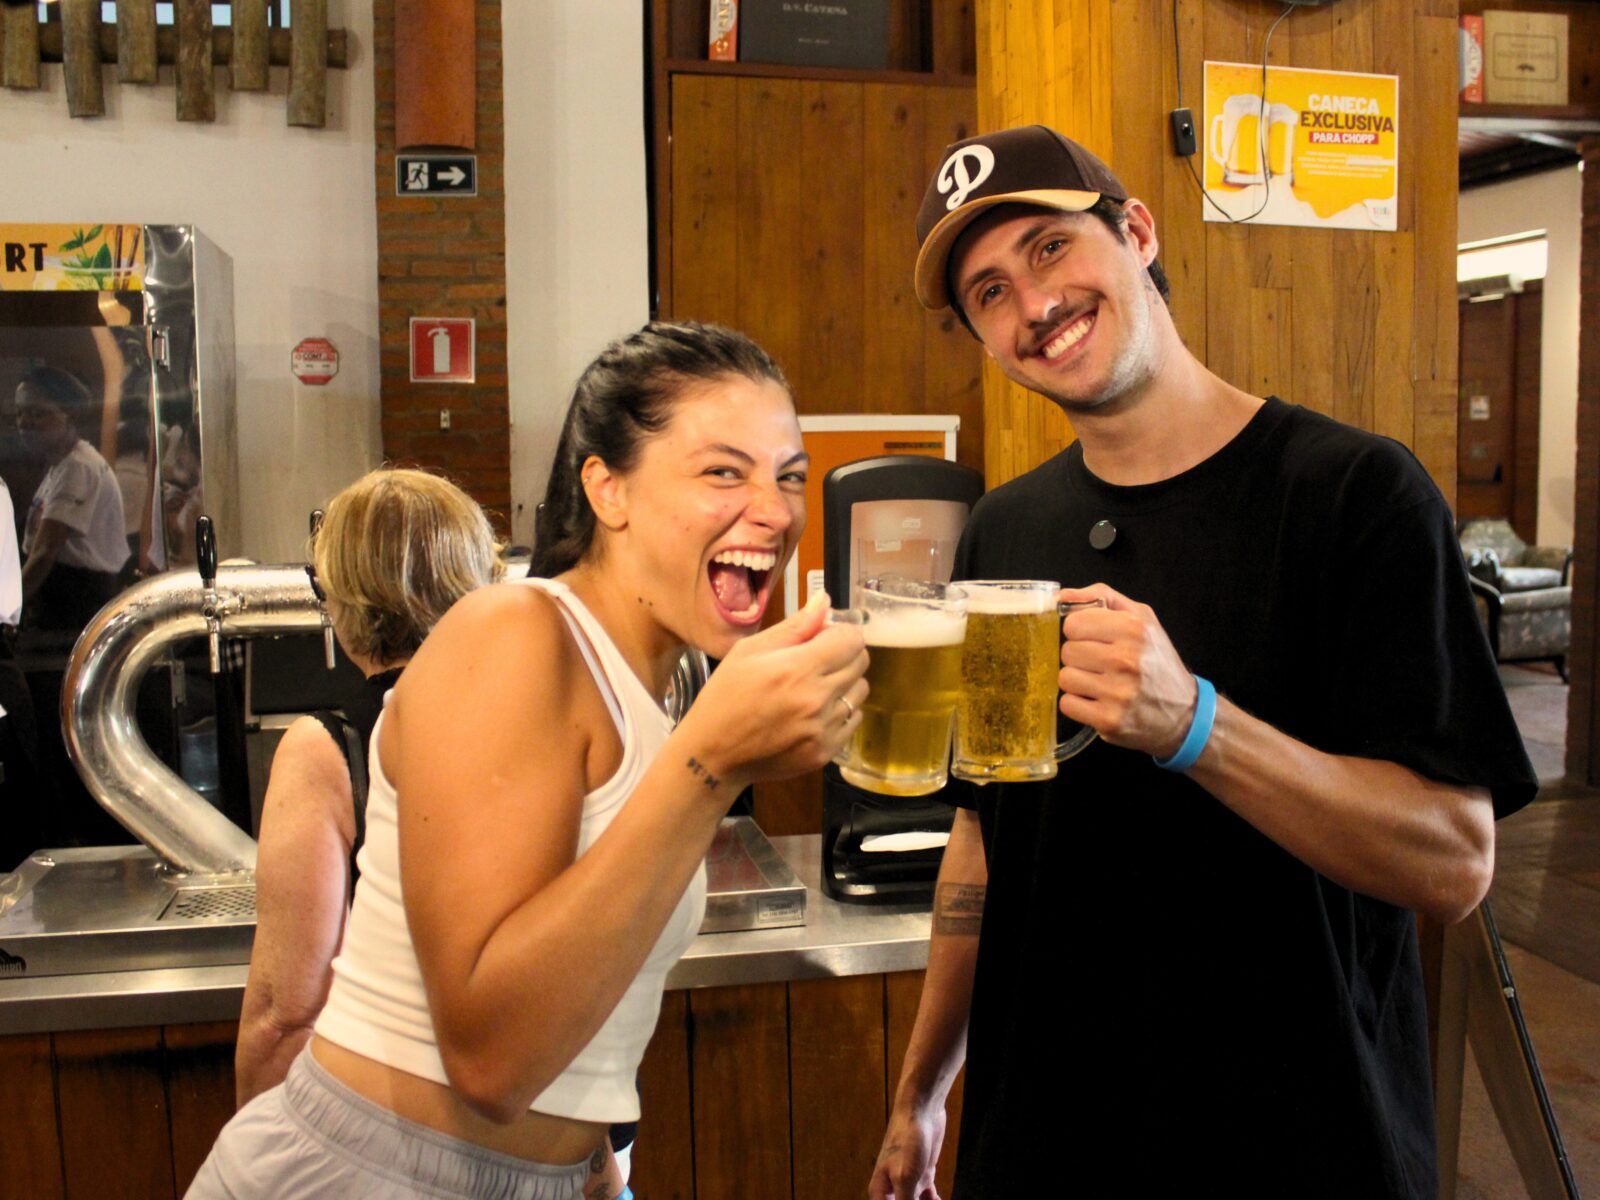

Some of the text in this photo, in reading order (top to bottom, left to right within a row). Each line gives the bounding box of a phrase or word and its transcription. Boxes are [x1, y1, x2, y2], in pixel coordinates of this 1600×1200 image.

[1308, 93, 1380, 115] CANECA
[1300, 110, 1395, 133] EXCLUSIVA
[1312, 132, 1376, 144] PARA CHOPP
